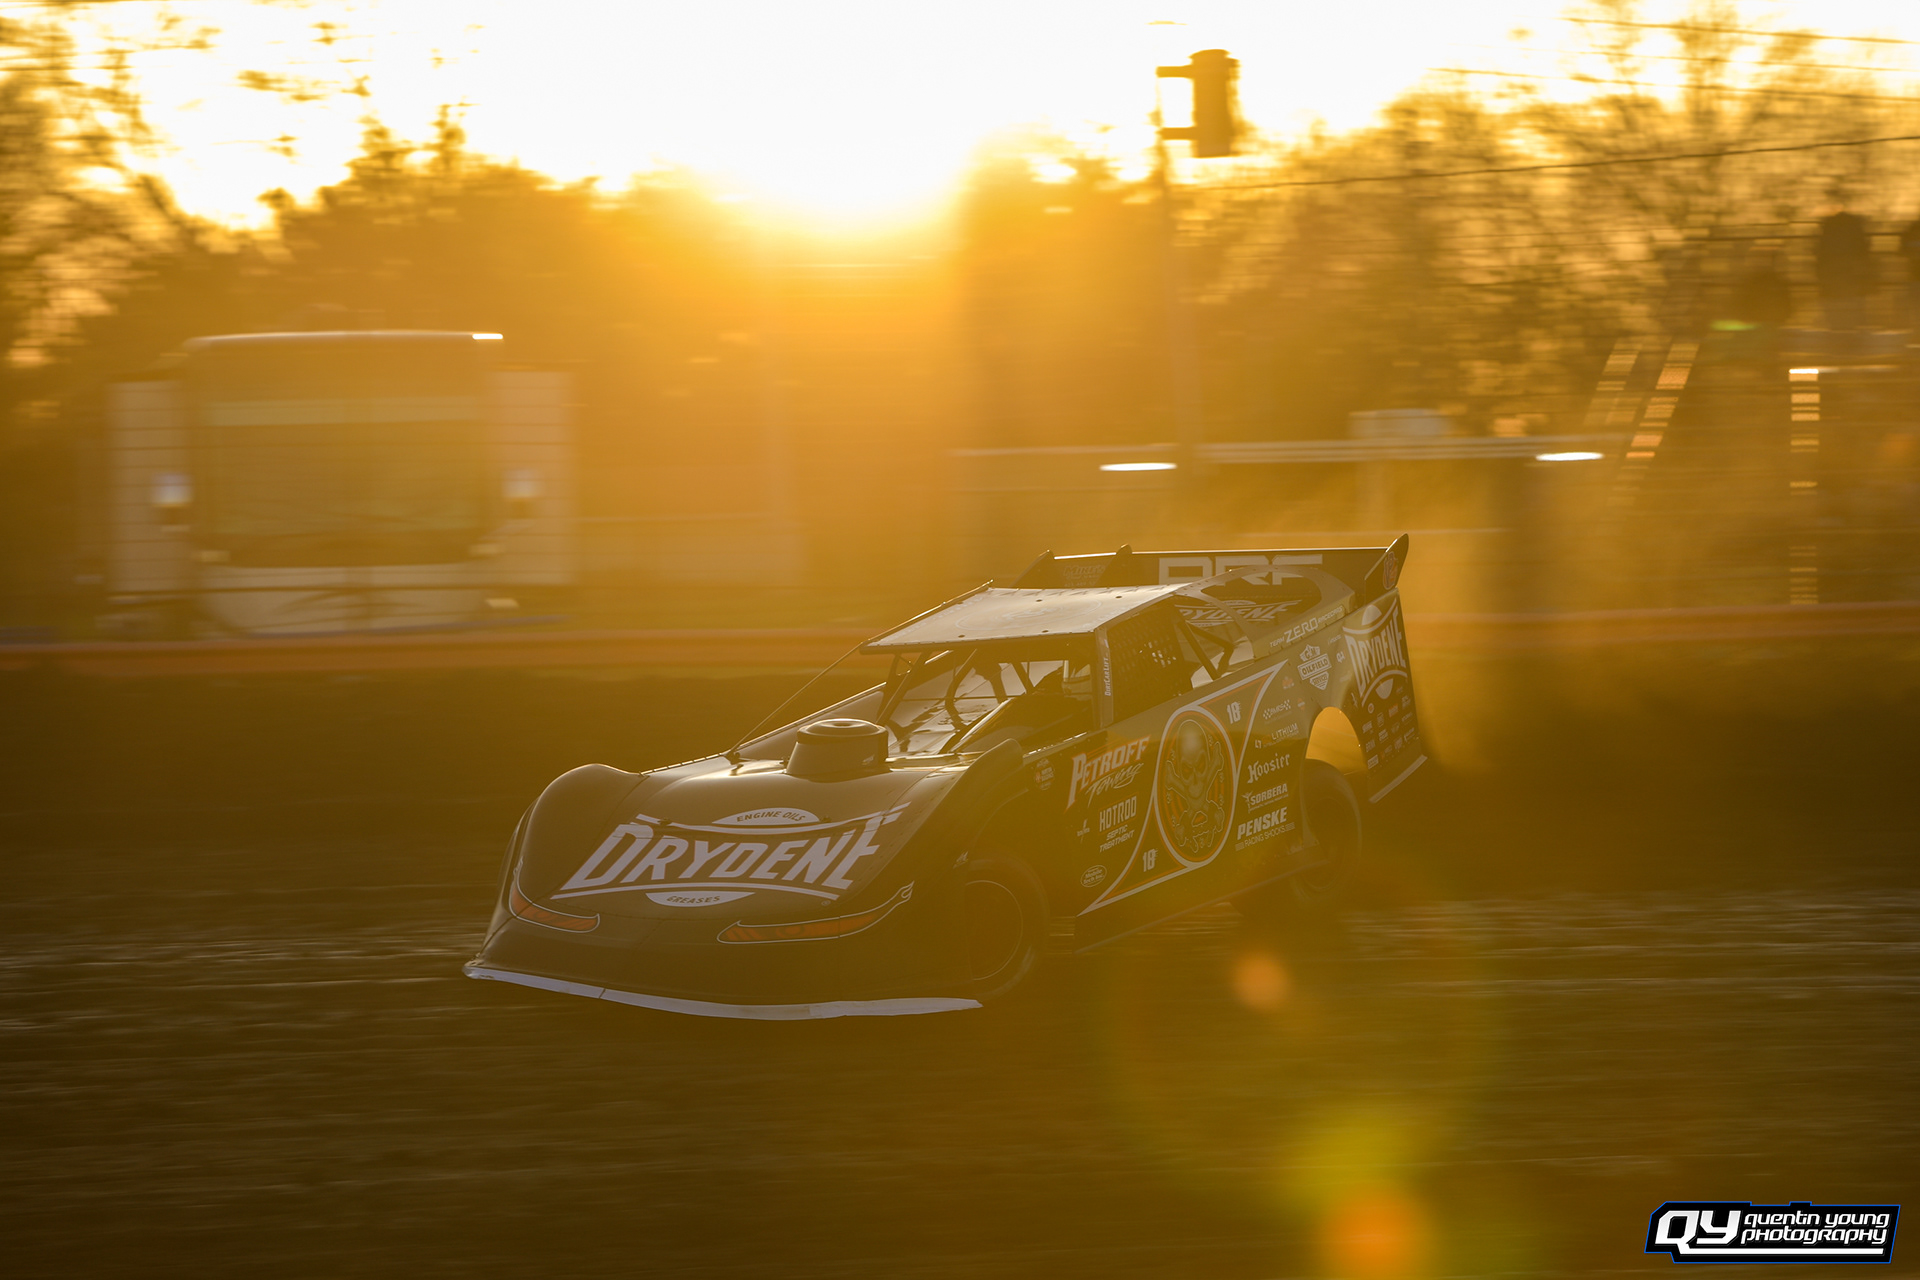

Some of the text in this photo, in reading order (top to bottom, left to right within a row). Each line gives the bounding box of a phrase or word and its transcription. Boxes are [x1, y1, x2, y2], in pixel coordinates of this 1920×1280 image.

[1270, 636, 1284, 647] TEAM
[1284, 617, 1319, 643] ZERO
[1345, 606, 1406, 698] DRYDENE
[1301, 658, 1329, 676] OILFIELD
[1227, 701, 1241, 724] 18
[1271, 723, 1299, 740] LITHIUM
[1066, 735, 1151, 811] PETROFF
[1247, 753, 1290, 784] Hoosier
[1250, 783, 1288, 806] SORBERA
[737, 811, 806, 822] ENGINE OILS
[1100, 796, 1137, 832] HOTROD
[1237, 807, 1288, 840] PENSKE
[1100, 830, 1134, 853] TREATMENT
[1106, 824, 1128, 840] SEPTIC
[1244, 825, 1286, 847] RACING SHOCKS
[560, 811, 902, 890] DRYDENE
[1143, 848, 1158, 873] 18
[667, 896, 720, 904] GREASES
